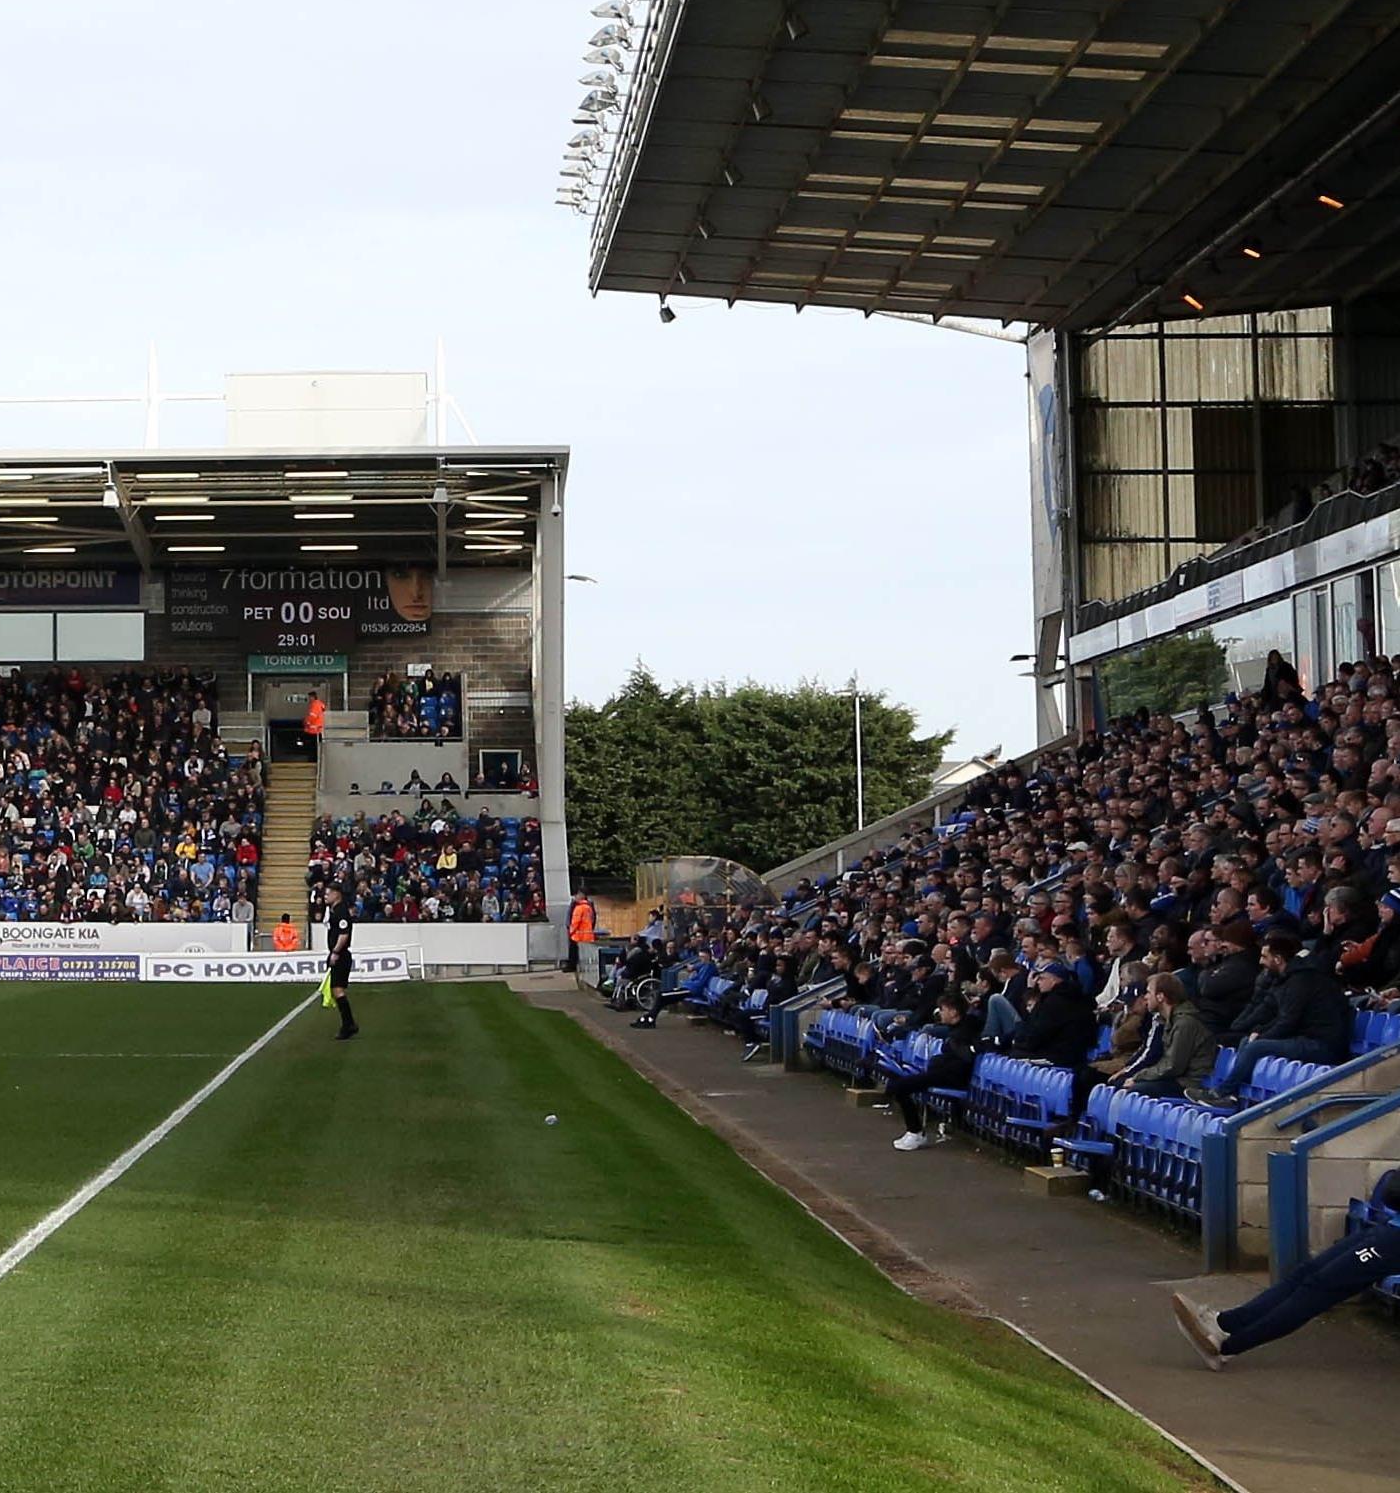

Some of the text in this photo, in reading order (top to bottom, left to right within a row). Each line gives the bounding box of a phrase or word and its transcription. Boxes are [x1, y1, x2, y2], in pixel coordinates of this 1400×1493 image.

[367, 595, 390, 610] ltd
[171, 604, 230, 615] construction
[243, 607, 274, 620] PET
[317, 606, 351, 620] SOU
[391, 623, 428, 633] 202954
[277, 634, 316, 647] 29:01
[264, 655, 335, 666] TORNEY LTD
[2, 927, 100, 939] BOONGATE KIA
[153, 962, 194, 978] PC
